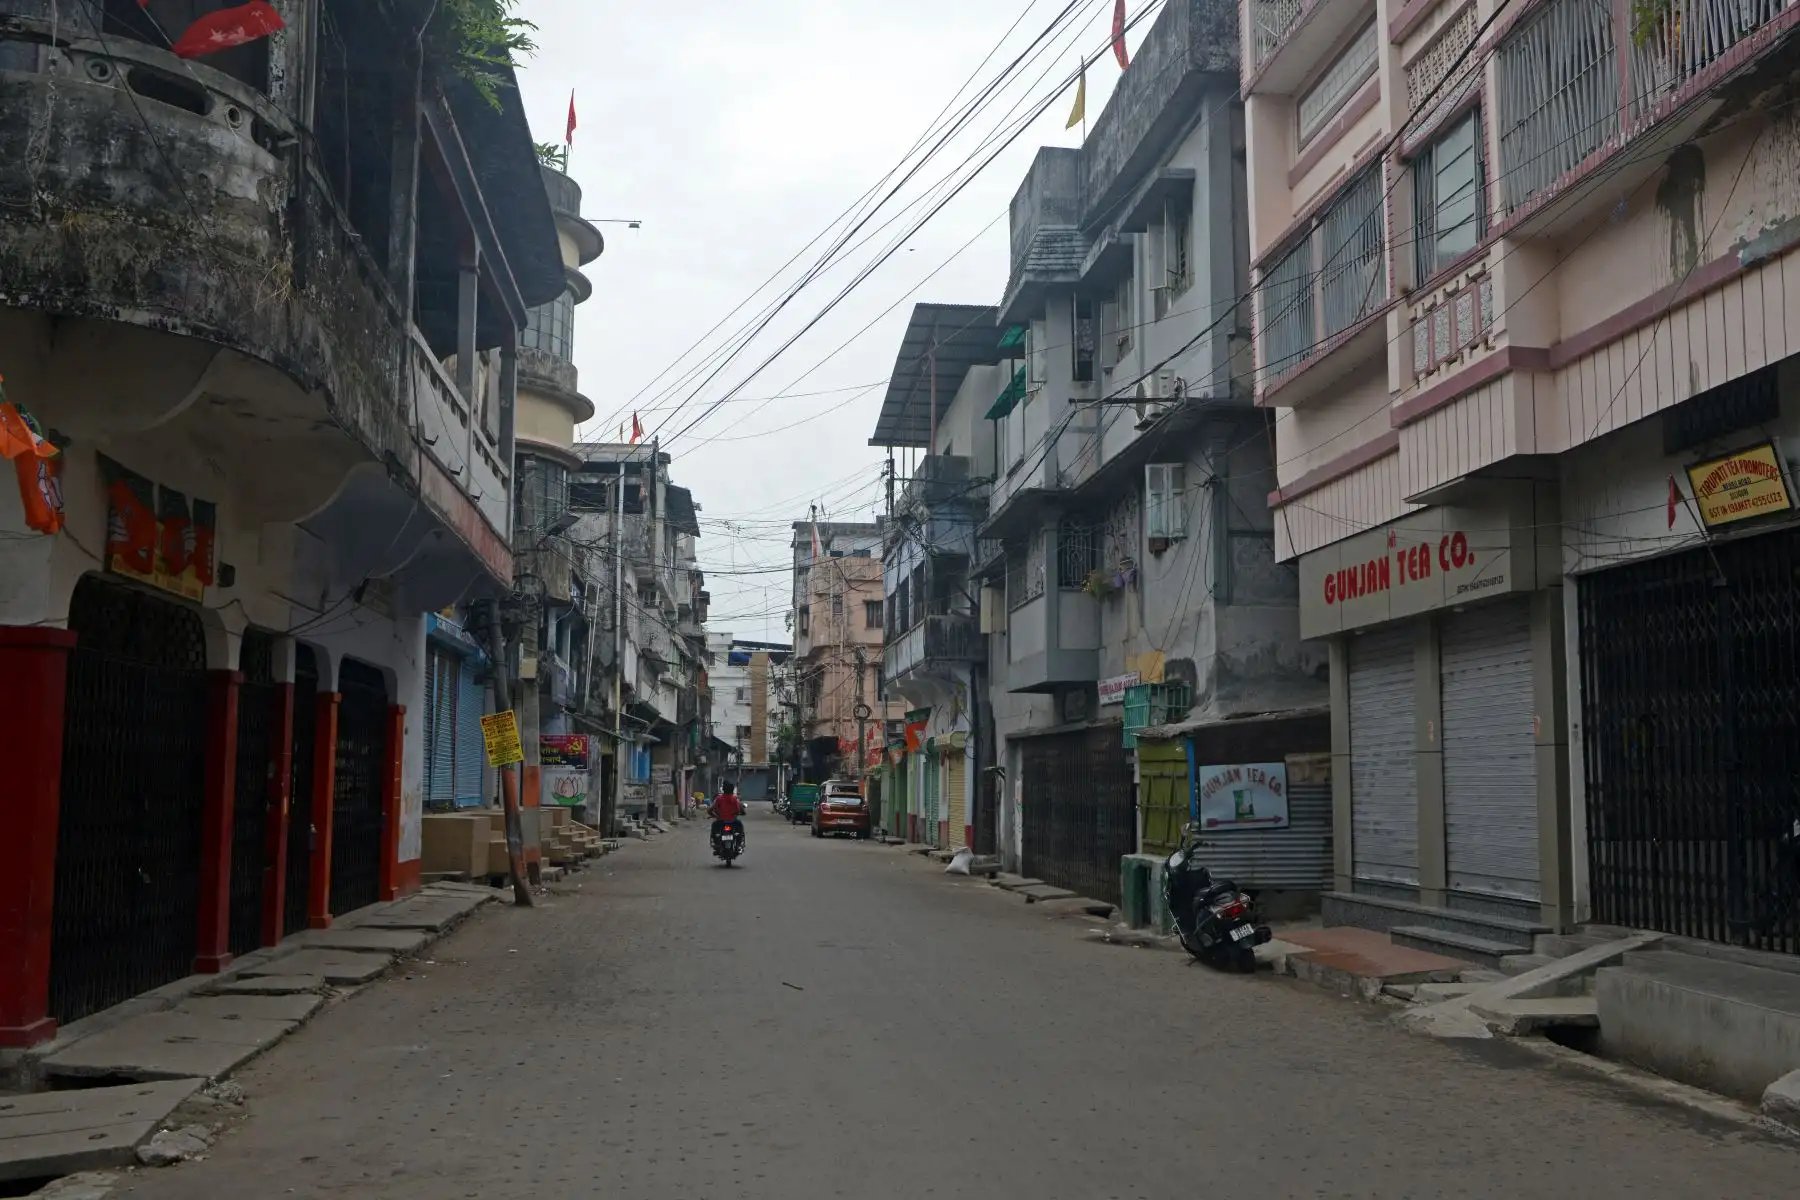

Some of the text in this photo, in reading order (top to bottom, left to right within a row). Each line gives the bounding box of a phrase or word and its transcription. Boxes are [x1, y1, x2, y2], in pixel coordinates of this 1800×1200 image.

[1699, 460, 1779, 499] TIRUPATI TEA PROMOTERS
[1325, 556, 1390, 605] GUNJAN
[1397, 541, 1431, 586] TEA
[1439, 531, 1475, 572] CO.
